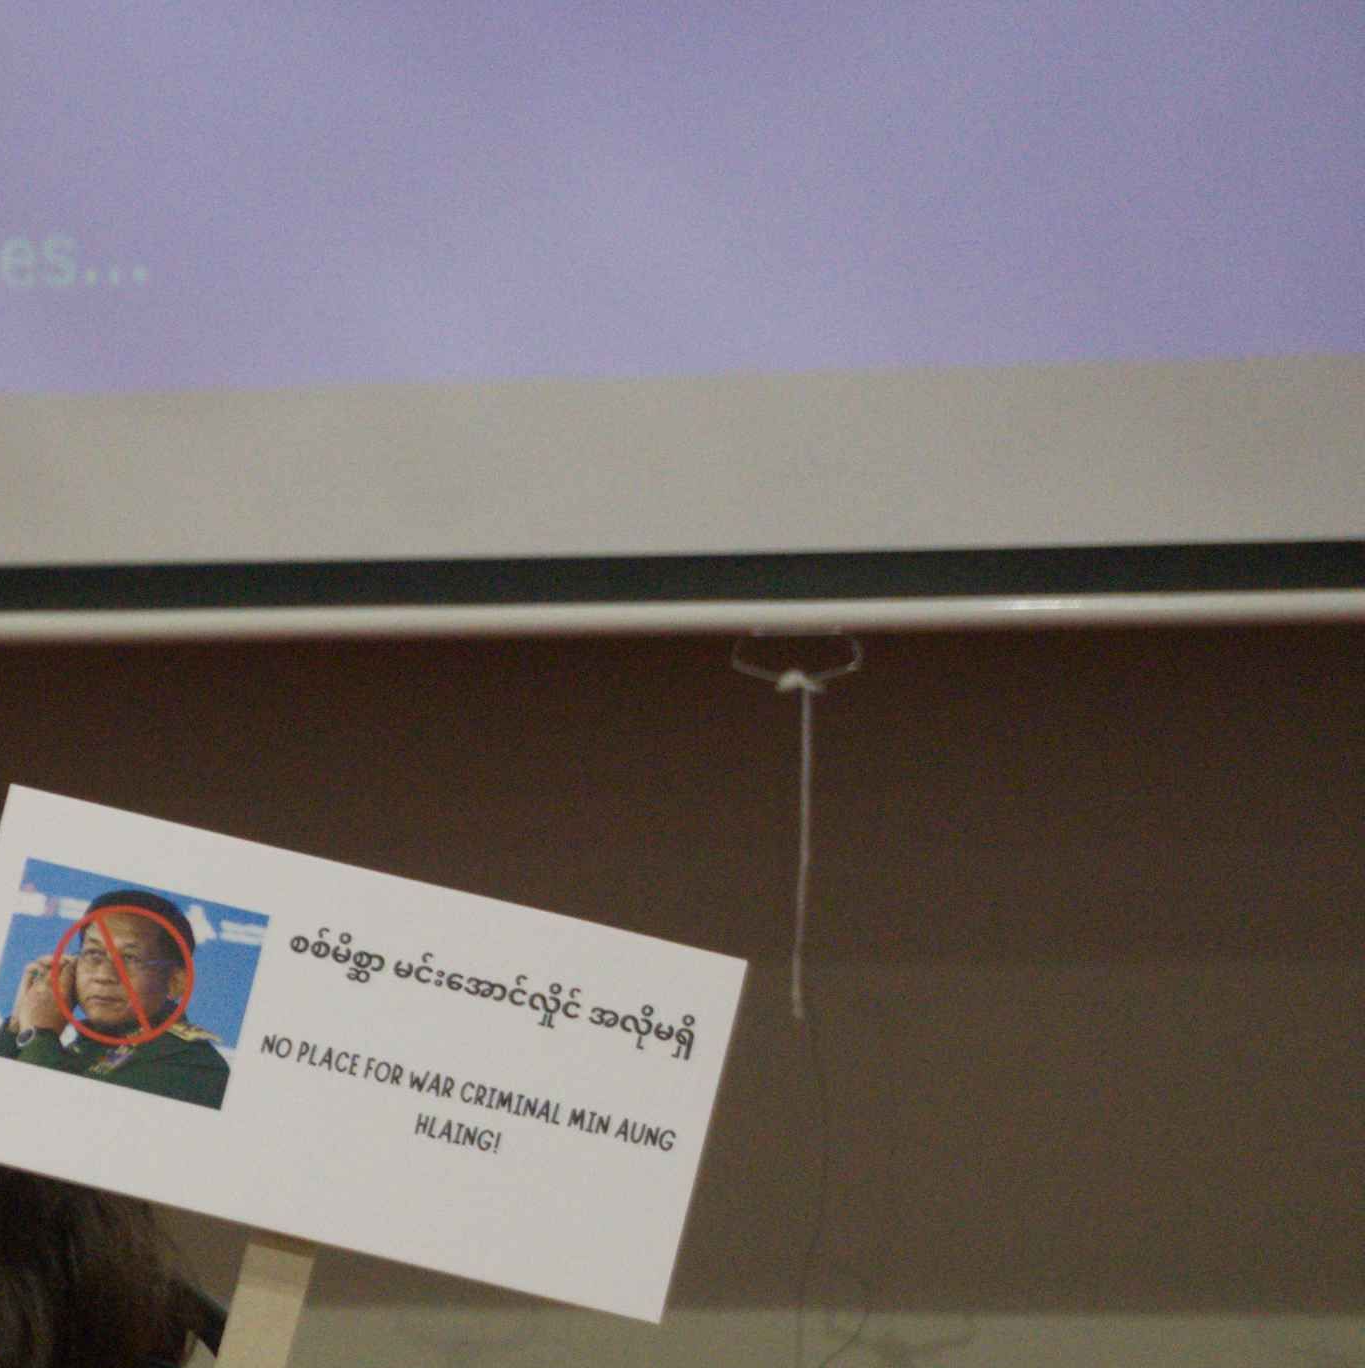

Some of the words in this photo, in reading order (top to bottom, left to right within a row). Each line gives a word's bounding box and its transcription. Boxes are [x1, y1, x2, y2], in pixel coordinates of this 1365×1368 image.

[260, 1034, 293, 1059] NO
[296, 1041, 360, 1077] PLACE
[363, 1056, 404, 1087] FOR
[409, 1070, 456, 1099] WAR
[459, 1081, 561, 1126] CRIMINAL
[567, 1108, 612, 1136] MIN
[614, 1118, 677, 1152] AUNG
[414, 1112, 503, 1153] HLAING!
